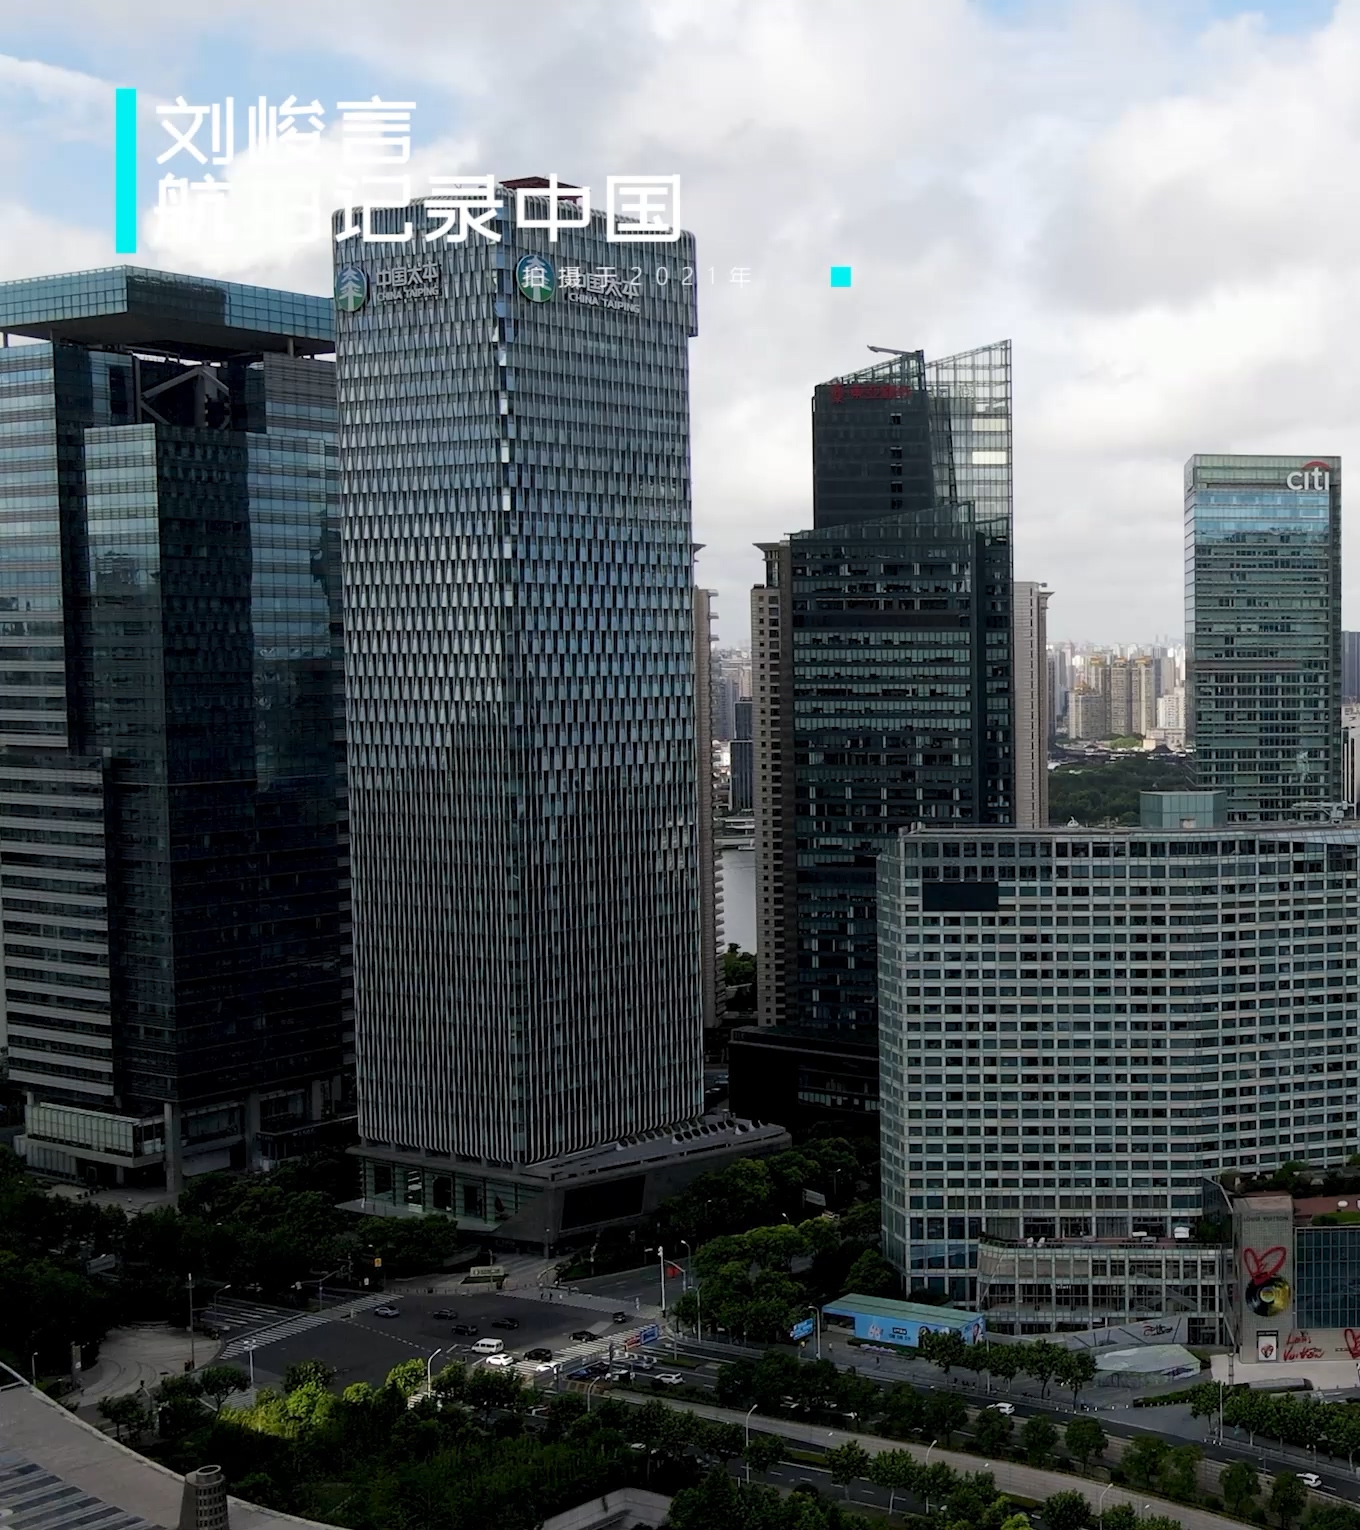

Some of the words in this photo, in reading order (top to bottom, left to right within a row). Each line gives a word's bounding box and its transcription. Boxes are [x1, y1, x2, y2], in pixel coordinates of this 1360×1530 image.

[376, 290, 402, 300] CHINA
[404, 286, 440, 299] TAIPING
[567, 292, 599, 307] CHINA
[603, 300, 641, 314] TAIPING
